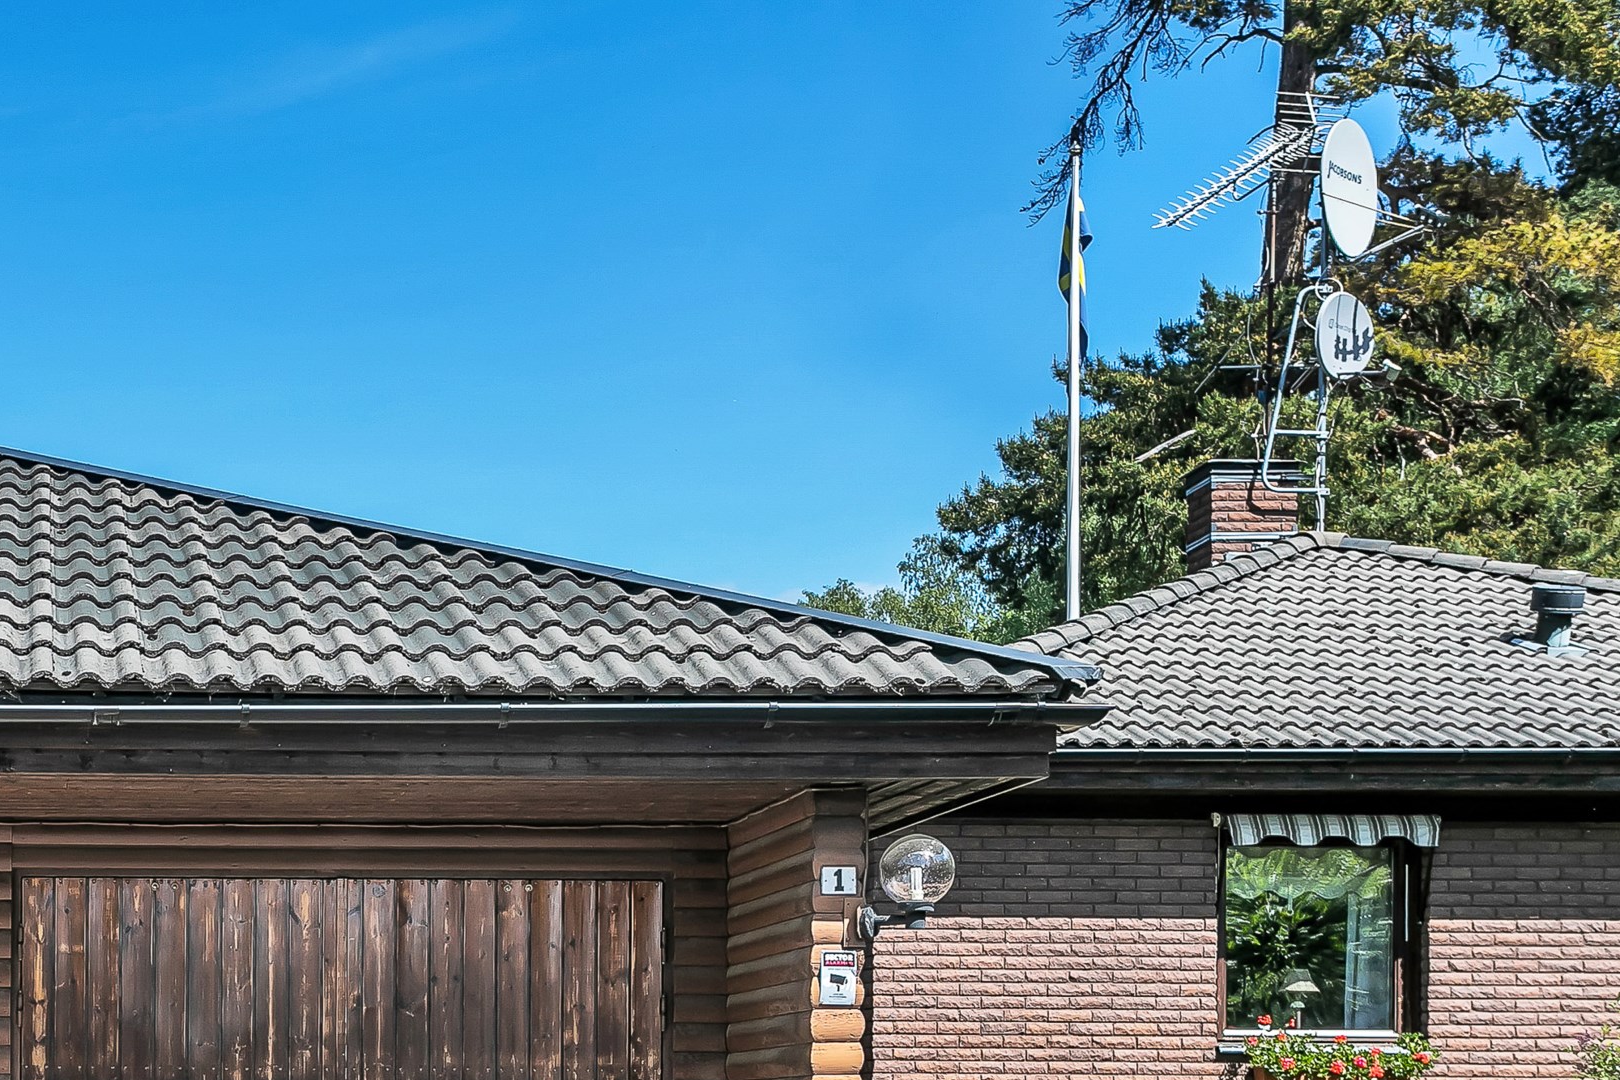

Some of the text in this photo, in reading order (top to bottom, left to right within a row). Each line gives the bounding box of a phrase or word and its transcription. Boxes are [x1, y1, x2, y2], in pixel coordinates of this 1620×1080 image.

[1327, 160, 1362, 184] JACOBSONS
[834, 869, 844, 891] 1
[824, 953, 854, 961] SECTOR
